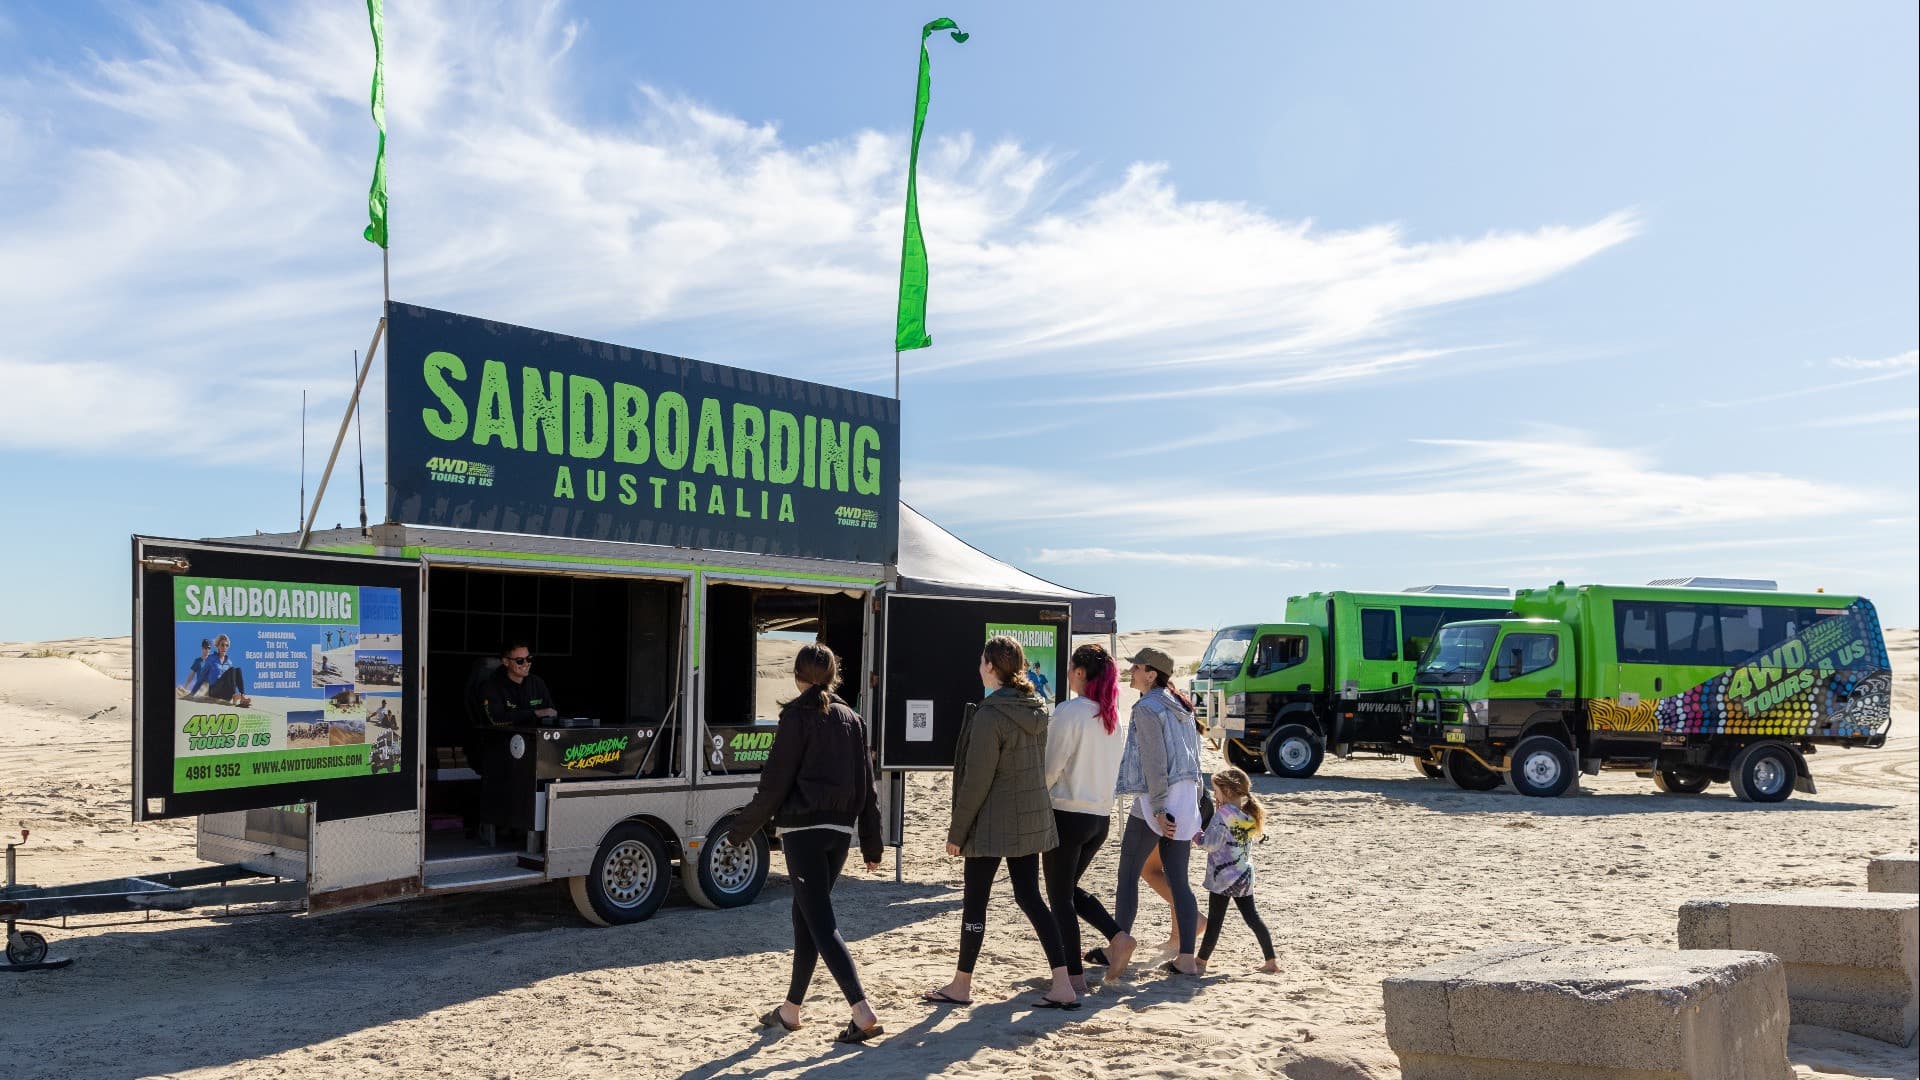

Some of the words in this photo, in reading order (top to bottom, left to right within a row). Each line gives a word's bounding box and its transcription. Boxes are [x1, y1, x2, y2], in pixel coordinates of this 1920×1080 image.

[422, 351, 881, 496] SANDBOARDING
[426, 456, 468, 474] 4WD
[431, 471, 466, 484] TOURS
[467, 476, 476, 485] R
[479, 477, 494, 487] US
[553, 466, 795, 524] AUSTRALIA
[834, 505, 862, 519] 4WD
[837, 517, 860, 527] TOURS
[868, 521, 878, 529] US
[185, 584, 352, 619] SANDBOARDING
[1728, 639, 1808, 700] 4WD
[1744, 668, 1815, 718] TOURS
[1818, 656, 1836, 680] R
[1838, 639, 1866, 666] US
[183, 713, 240, 736] 4WD
[189, 734, 236, 751] TOURS
[236, 733, 249, 748] R
[252, 732, 272, 747] US
[564, 735, 628, 762] SANDBOARDING
[729, 731, 774, 750] 4WD
[253, 753, 363, 775] WWW.4WDTOURSRUS.COM
[574, 749, 621, 769] AUSTRALIA
[733, 750, 770, 762] TOURS
[185, 764, 212, 780] 4981
[214, 762, 241, 778] 9352
